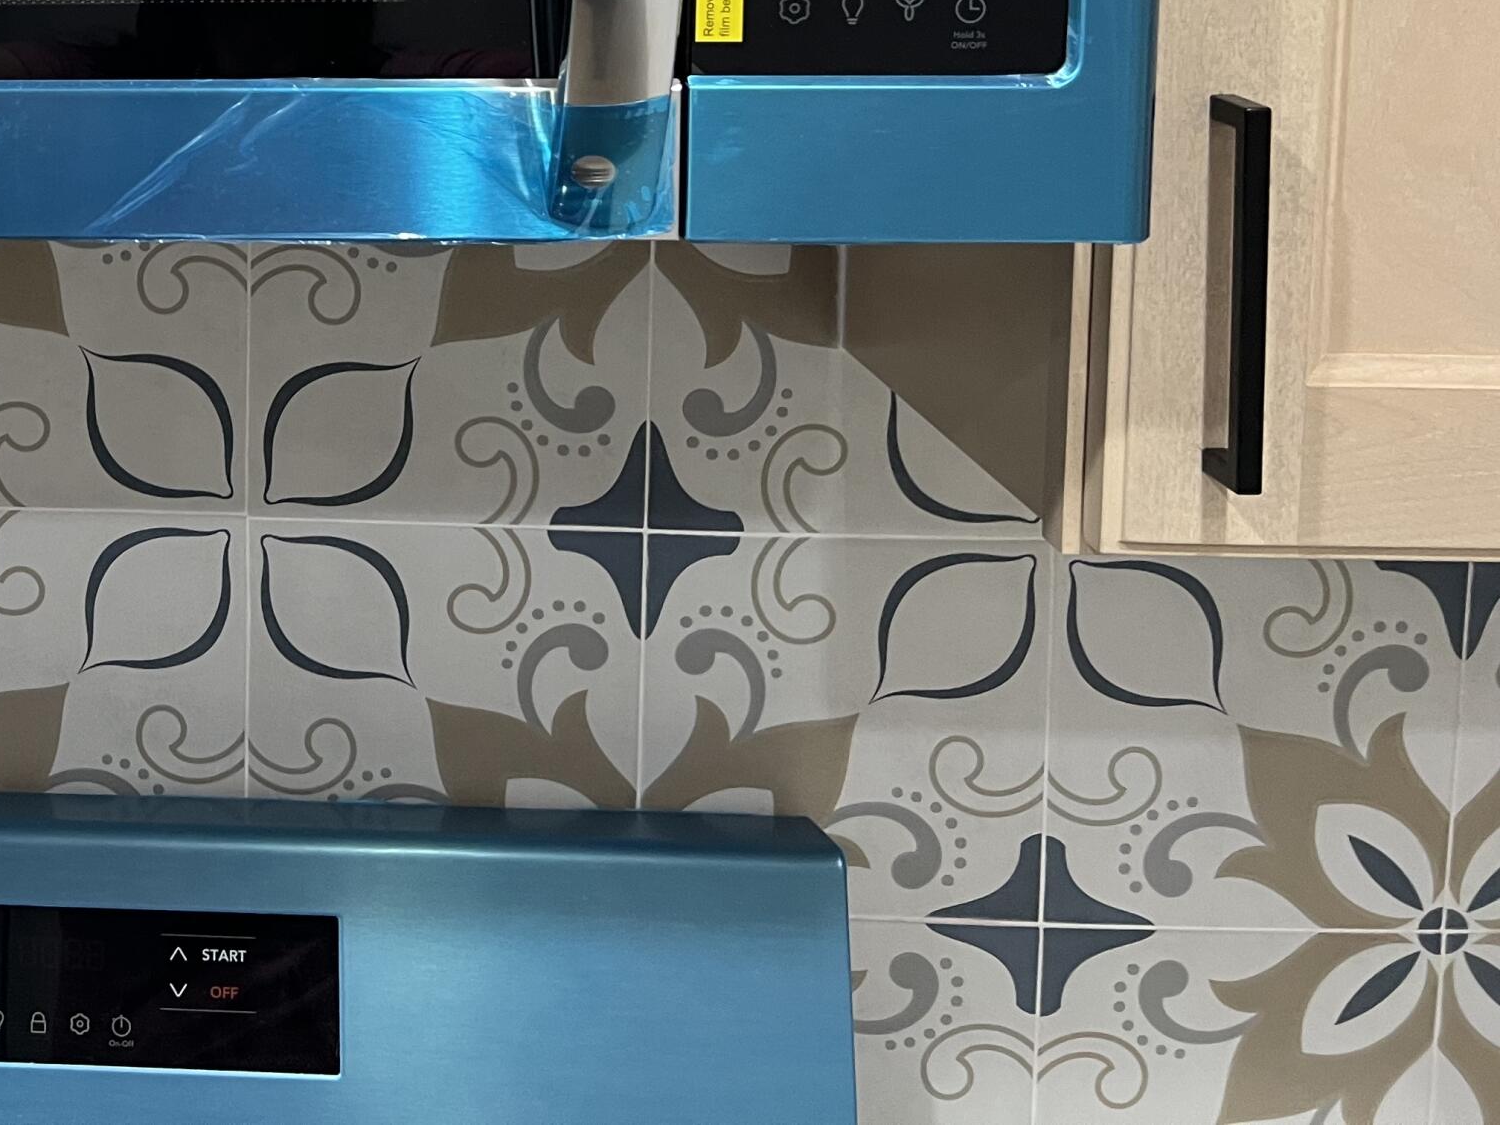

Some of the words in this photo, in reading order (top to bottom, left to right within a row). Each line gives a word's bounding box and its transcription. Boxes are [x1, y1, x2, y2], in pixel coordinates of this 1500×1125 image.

[719, 17, 730, 37] film
[951, 41, 987, 49] ON/OFF
[201, 948, 246, 963] START
[210, 985, 239, 999] OFF
